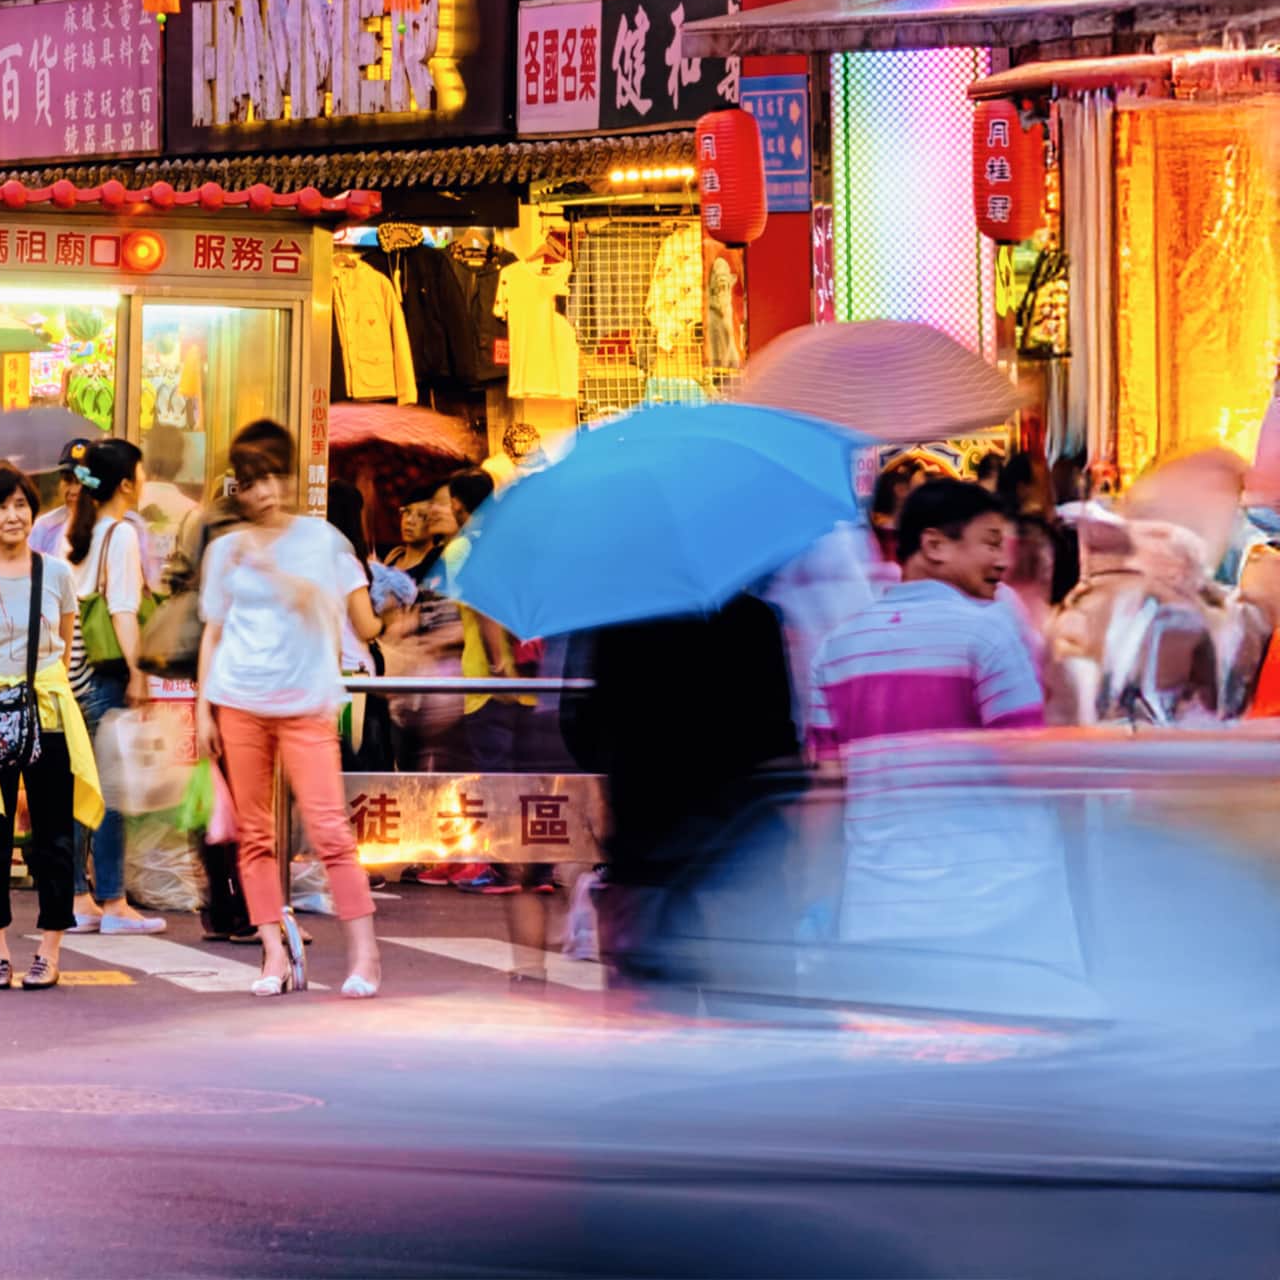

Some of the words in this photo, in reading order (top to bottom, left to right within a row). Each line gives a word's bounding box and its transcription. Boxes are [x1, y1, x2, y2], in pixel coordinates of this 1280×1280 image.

[194, 233, 303, 274] 服務台
[349, 793, 570, 846] 徒步區
